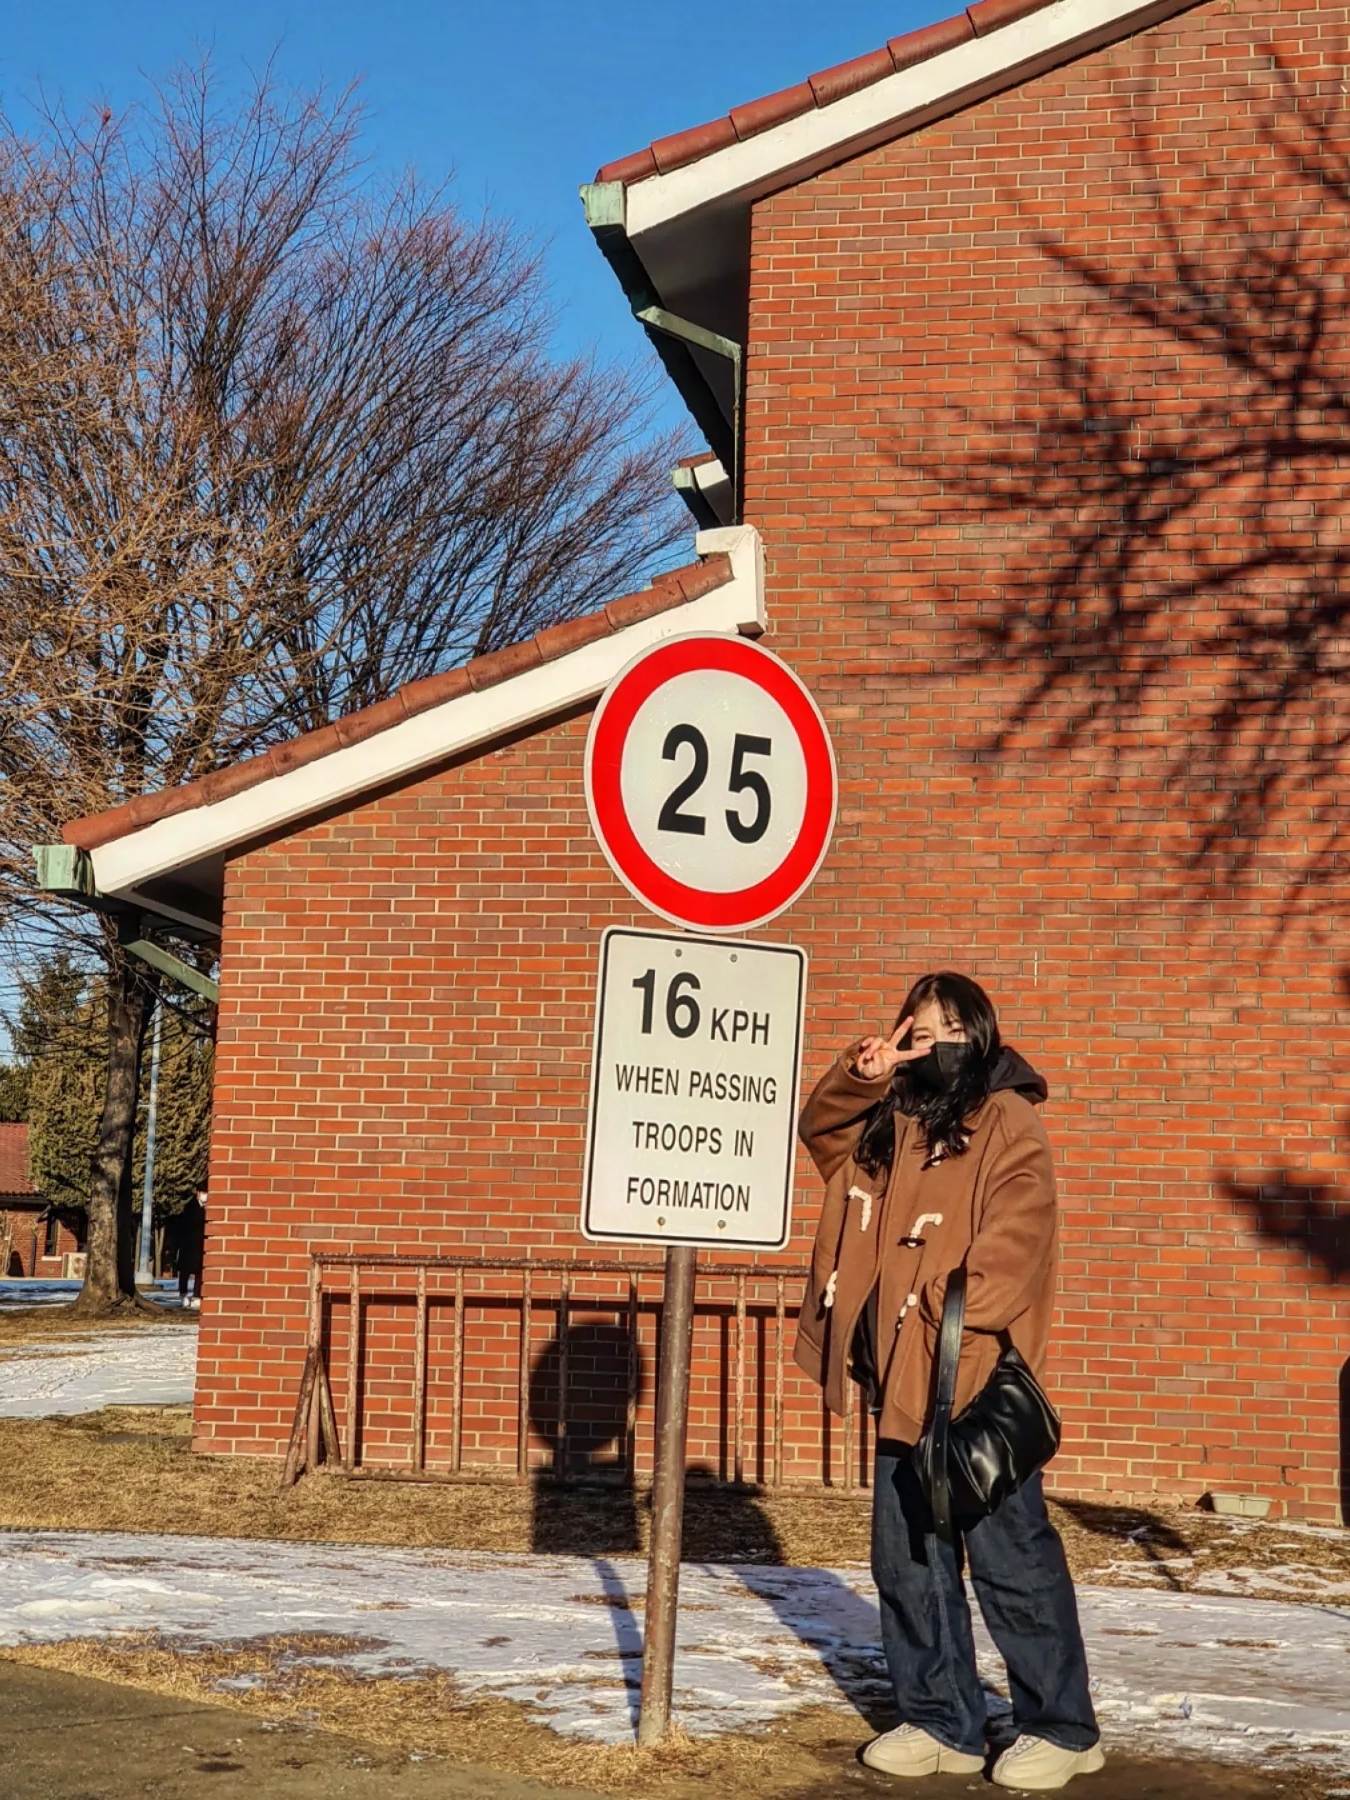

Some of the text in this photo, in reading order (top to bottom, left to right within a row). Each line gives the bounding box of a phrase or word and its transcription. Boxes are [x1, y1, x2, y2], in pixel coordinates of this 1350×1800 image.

[657, 723, 772, 844] 25
[632, 969, 770, 1046] 16 KPH
[615, 1063, 777, 1104] WHEN PASSING
[632, 1121, 753, 1157] TROOPS IN
[627, 1177, 751, 1212] FORMATION
